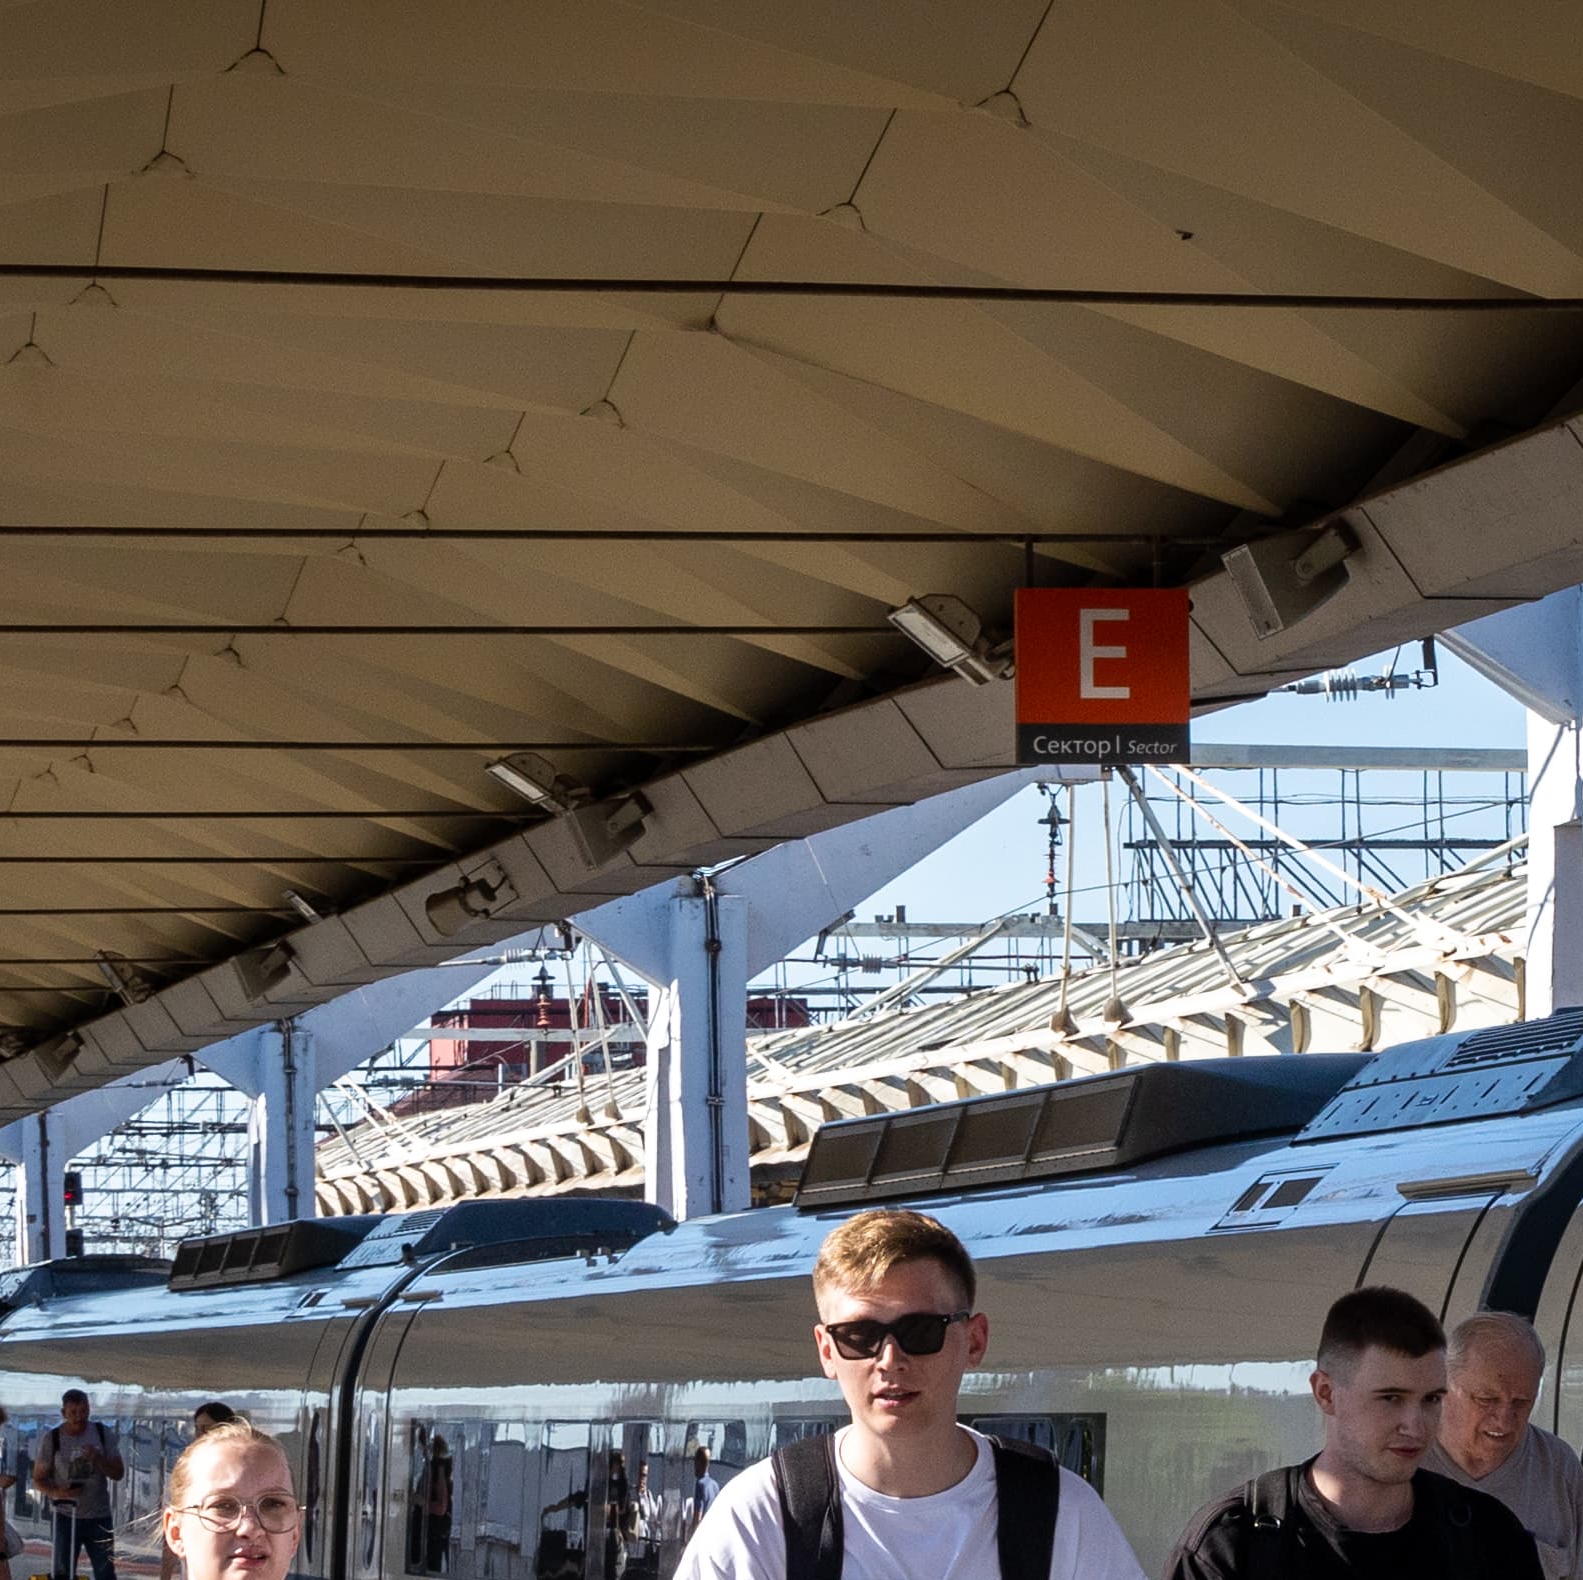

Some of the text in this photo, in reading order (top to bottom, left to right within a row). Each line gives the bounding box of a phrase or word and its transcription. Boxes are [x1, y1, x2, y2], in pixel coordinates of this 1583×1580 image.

[1080, 608, 1130, 699] E
[1032, 736, 1111, 758] Сектор
[1127, 740, 1177, 754] Sector
